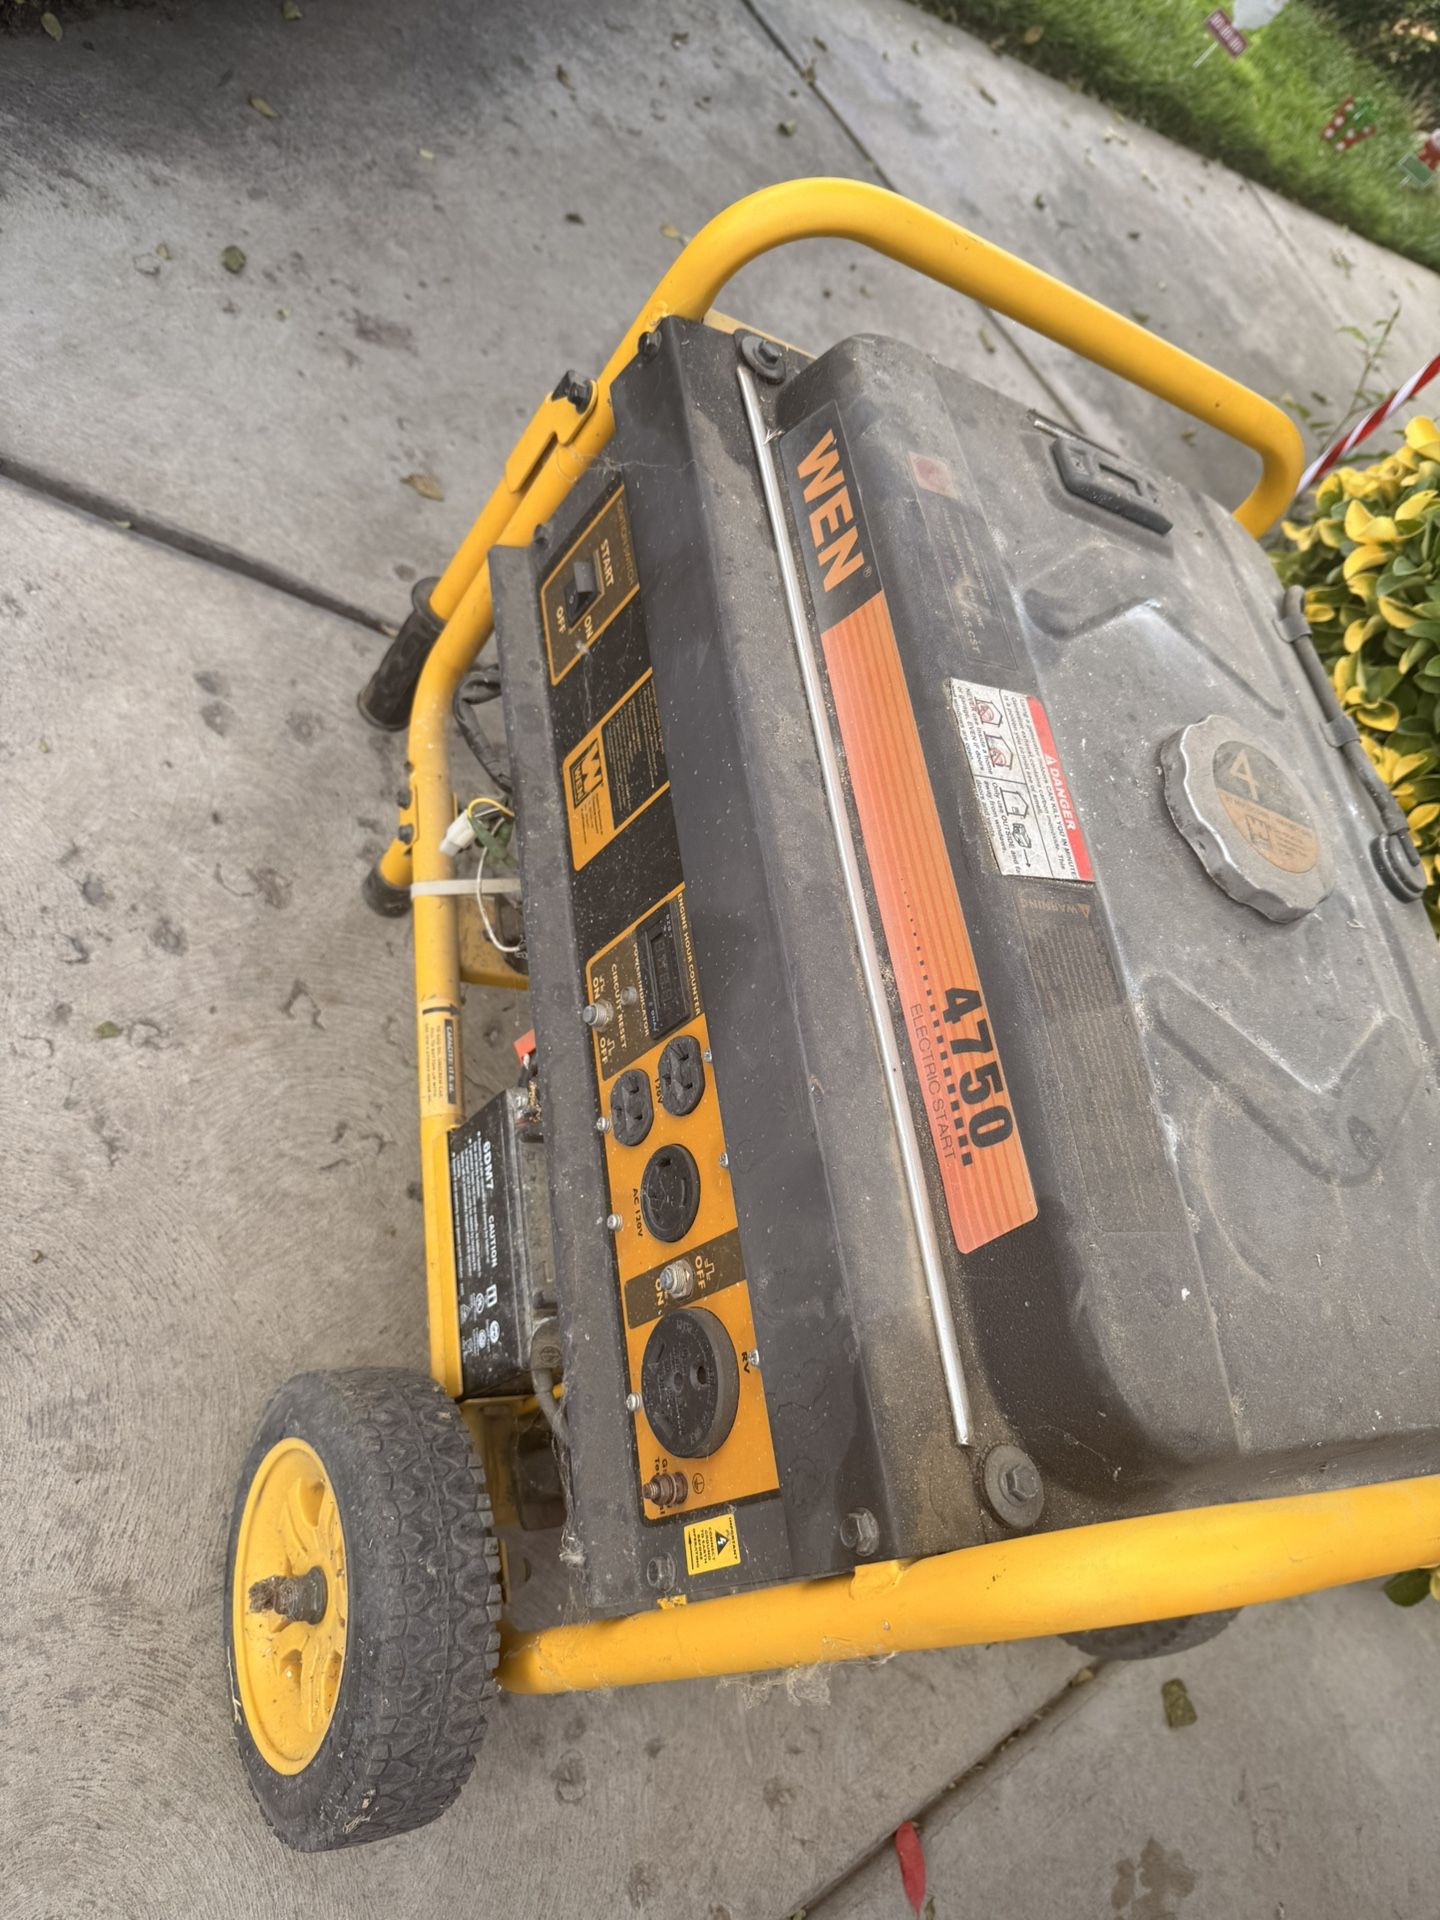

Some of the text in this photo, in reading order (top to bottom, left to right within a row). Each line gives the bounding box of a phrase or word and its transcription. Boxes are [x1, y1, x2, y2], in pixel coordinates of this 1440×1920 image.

[797, 428, 865, 593] WEN
[601, 539, 613, 585] START
[556, 606, 565, 633] OFF
[584, 615, 592, 638] ON
[967, 721, 976, 740] EVEN
[1038, 789, 1048, 813] carbon
[1045, 785, 1054, 801] CAN
[1051, 803, 1059, 818] KILL
[1056, 821, 1065, 836] YOU
[1050, 768, 1076, 831] DANGER
[1001, 815, 1014, 847] OUTSIDE
[677, 892, 700, 1014] ENGINE HOUR COUNTER
[592, 977, 600, 998] ON
[611, 963, 626, 1047] CIRCUIT RESET
[638, 980, 648, 1035] INDICATOR
[599, 1037, 607, 1063] OFF
[942, 987, 1013, 1149] 4750
[654, 1077, 664, 1103] 120V
[910, 1003, 956, 1159] ELECTRIC START
[632, 1188, 643, 1237] AC 120V
[488, 1215, 496, 1266] CAUTION
[655, 1277, 663, 1305] ON
[695, 1255, 705, 1287] OFF
[741, 1351, 749, 1373] RV
[728, 1517, 737, 1558] IMPORTANT
